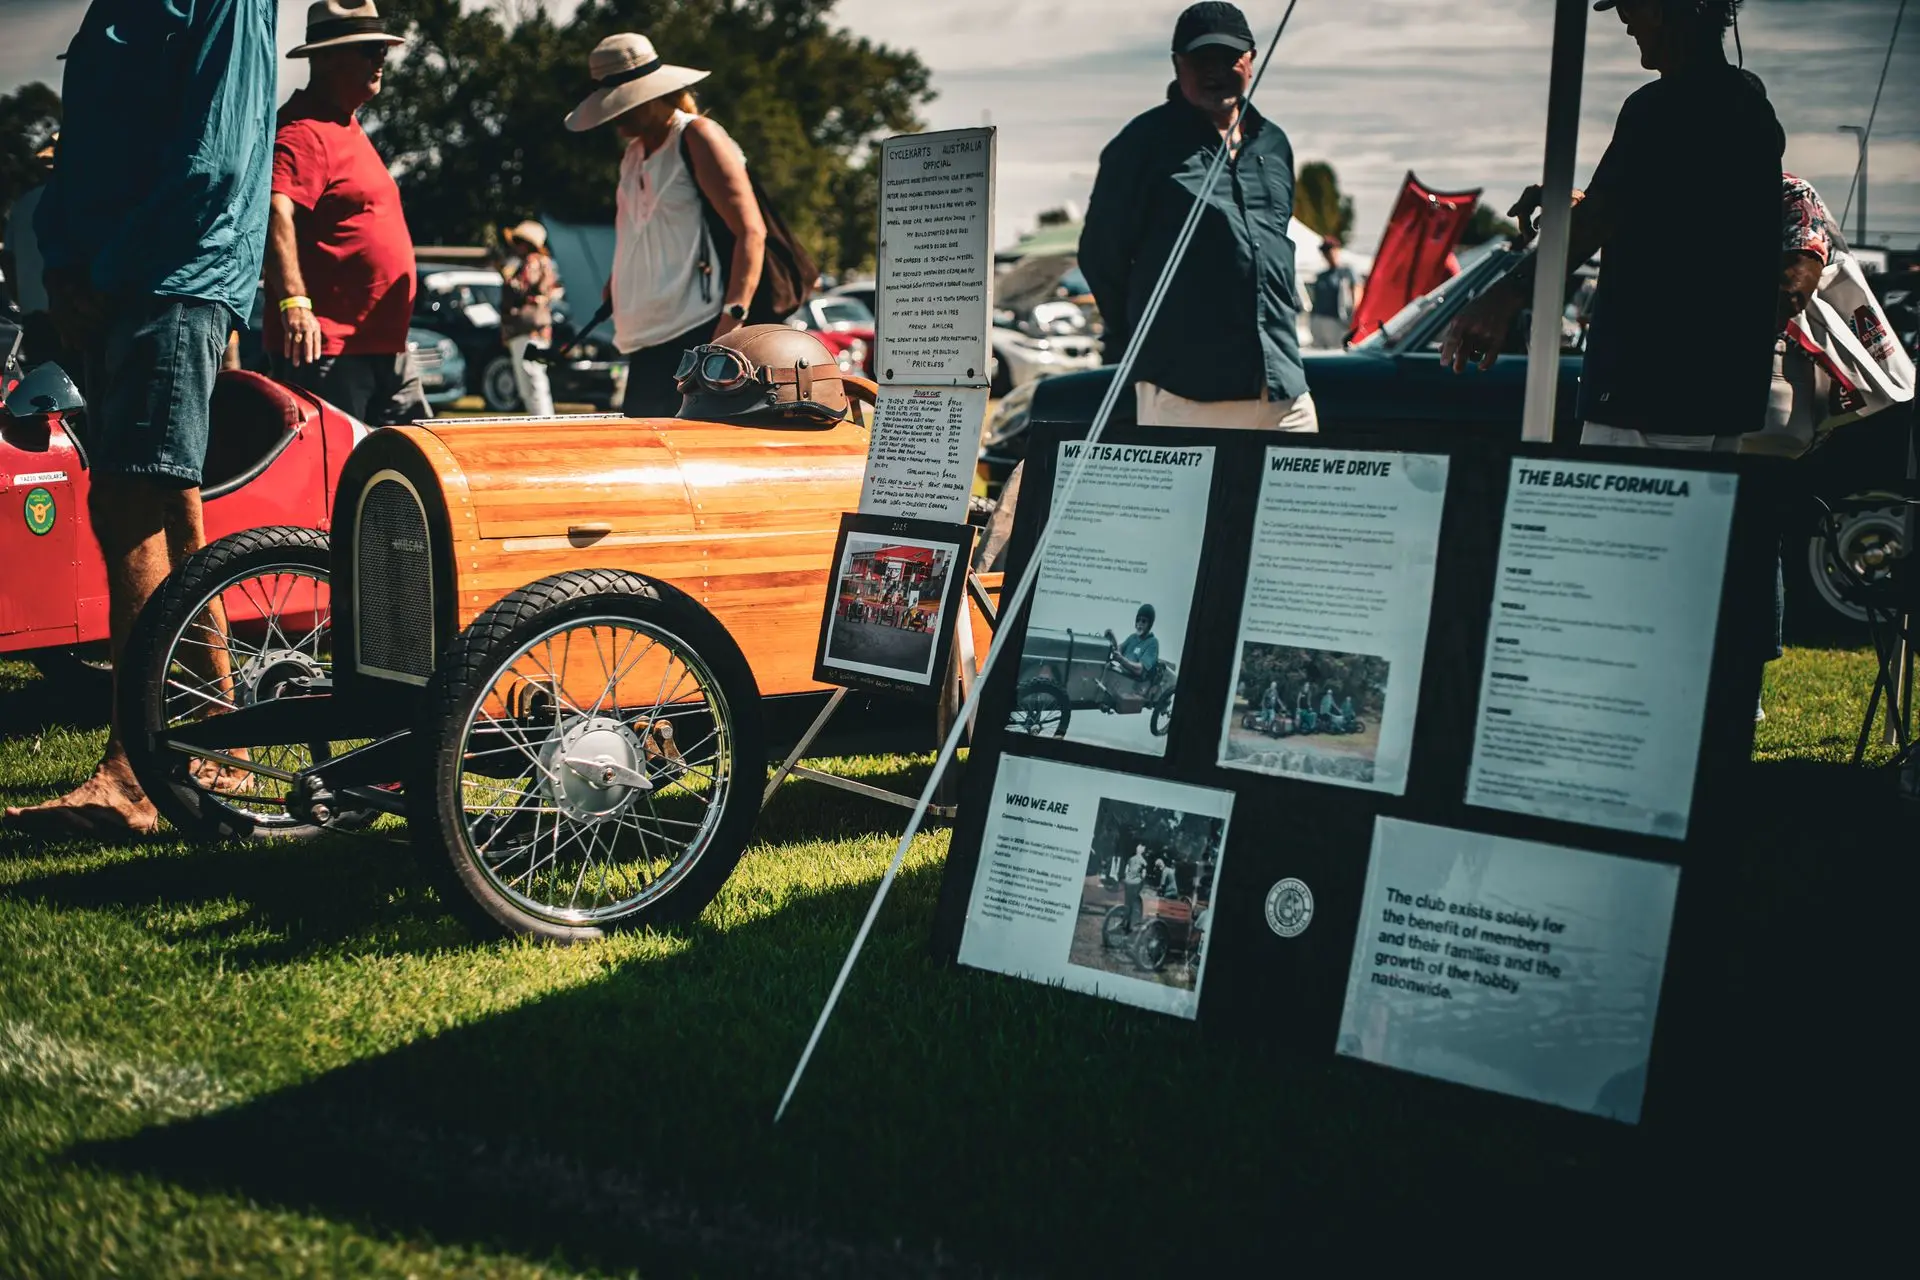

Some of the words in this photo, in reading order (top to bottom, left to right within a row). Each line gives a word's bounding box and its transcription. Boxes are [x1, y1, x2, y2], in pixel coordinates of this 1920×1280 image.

[889, 147, 931, 160] CYCLEKARTS
[943, 140, 982, 155] AUSTRALIA
[923, 159, 951, 170] OFFICIAL
[1100, 446, 1113, 460] IS
[1113, 448, 1121, 461] A
[1124, 449, 1203, 467] CYCLEKART?
[1271, 456, 1321, 473] WHERE
[1323, 459, 1345, 474] WE
[1347, 461, 1392, 477] DRIVE
[1518, 469, 1551, 486] THE
[1552, 471, 1602, 489] BASIC
[1604, 475, 1690, 498] FORMULA
[1006, 793, 1030, 808] WHO
[1030, 797, 1047, 811] WE
[1046, 801, 1069, 815] ARE
[1386, 887, 1412, 905] The
[1416, 894, 1446, 912] club
[1449, 902, 1492, 921] exists
[1496, 911, 1539, 932] solely
[1543, 917, 1566, 934] for
[1382, 909, 1405, 925] the
[1408, 913, 1459, 936] benefit
[1462, 926, 1478, 939] of
[1480, 931, 1551, 953] members
[1378, 931, 1405, 946] and
[1408, 934, 1441, 953] their
[1444, 942, 1500, 966] families
[1504, 956, 1533, 973] and
[1536, 960, 1562, 979] the
[1371, 971, 1453, 1000] nationwide.
[1375, 952, 1425, 972] growth
[1428, 962, 1443, 976] of
[1447, 964, 1470, 981] the
[1473, 971, 1520, 994] hobby
